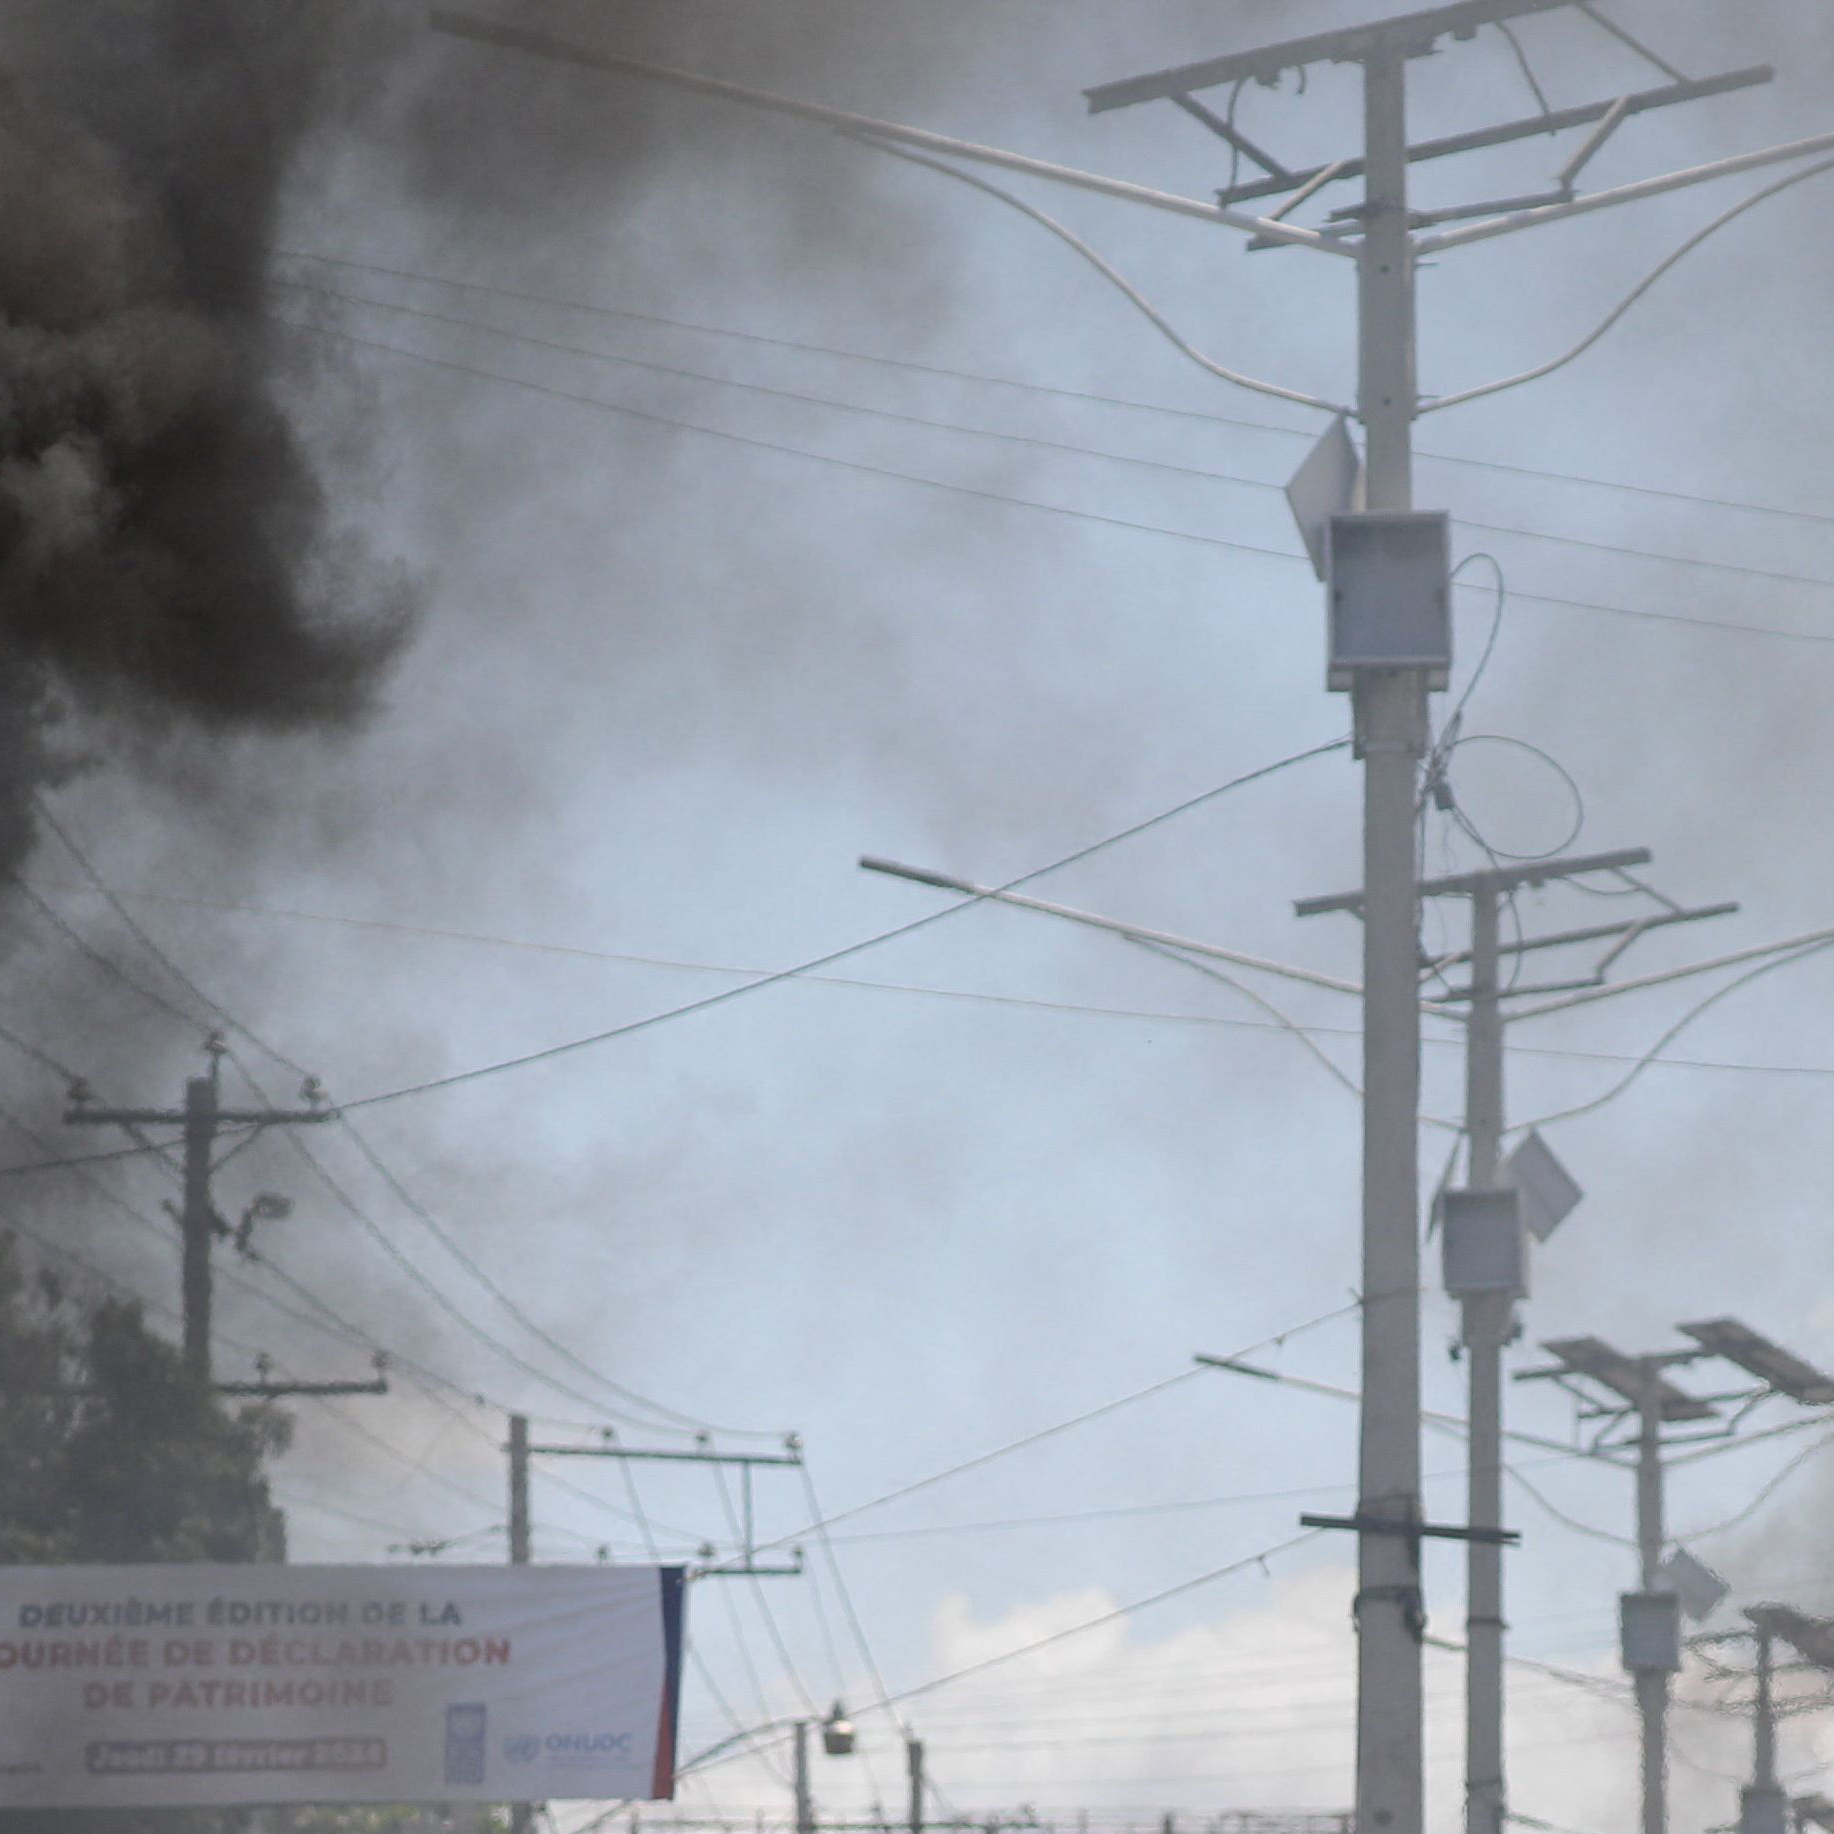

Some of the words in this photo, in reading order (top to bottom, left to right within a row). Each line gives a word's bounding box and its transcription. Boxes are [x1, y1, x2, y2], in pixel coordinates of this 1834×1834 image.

[20, 1596, 195, 1628] DEUXIÈME
[206, 1595, 348, 1625] ÉDITION
[362, 1602, 407, 1625] DE
[421, 1601, 463, 1626] LA
[163, 1639, 214, 1668] DE
[229, 1631, 511, 1667] DÉCLARATION
[82, 1681, 134, 1709] DE
[148, 1678, 393, 1708] PATRIMOINE
